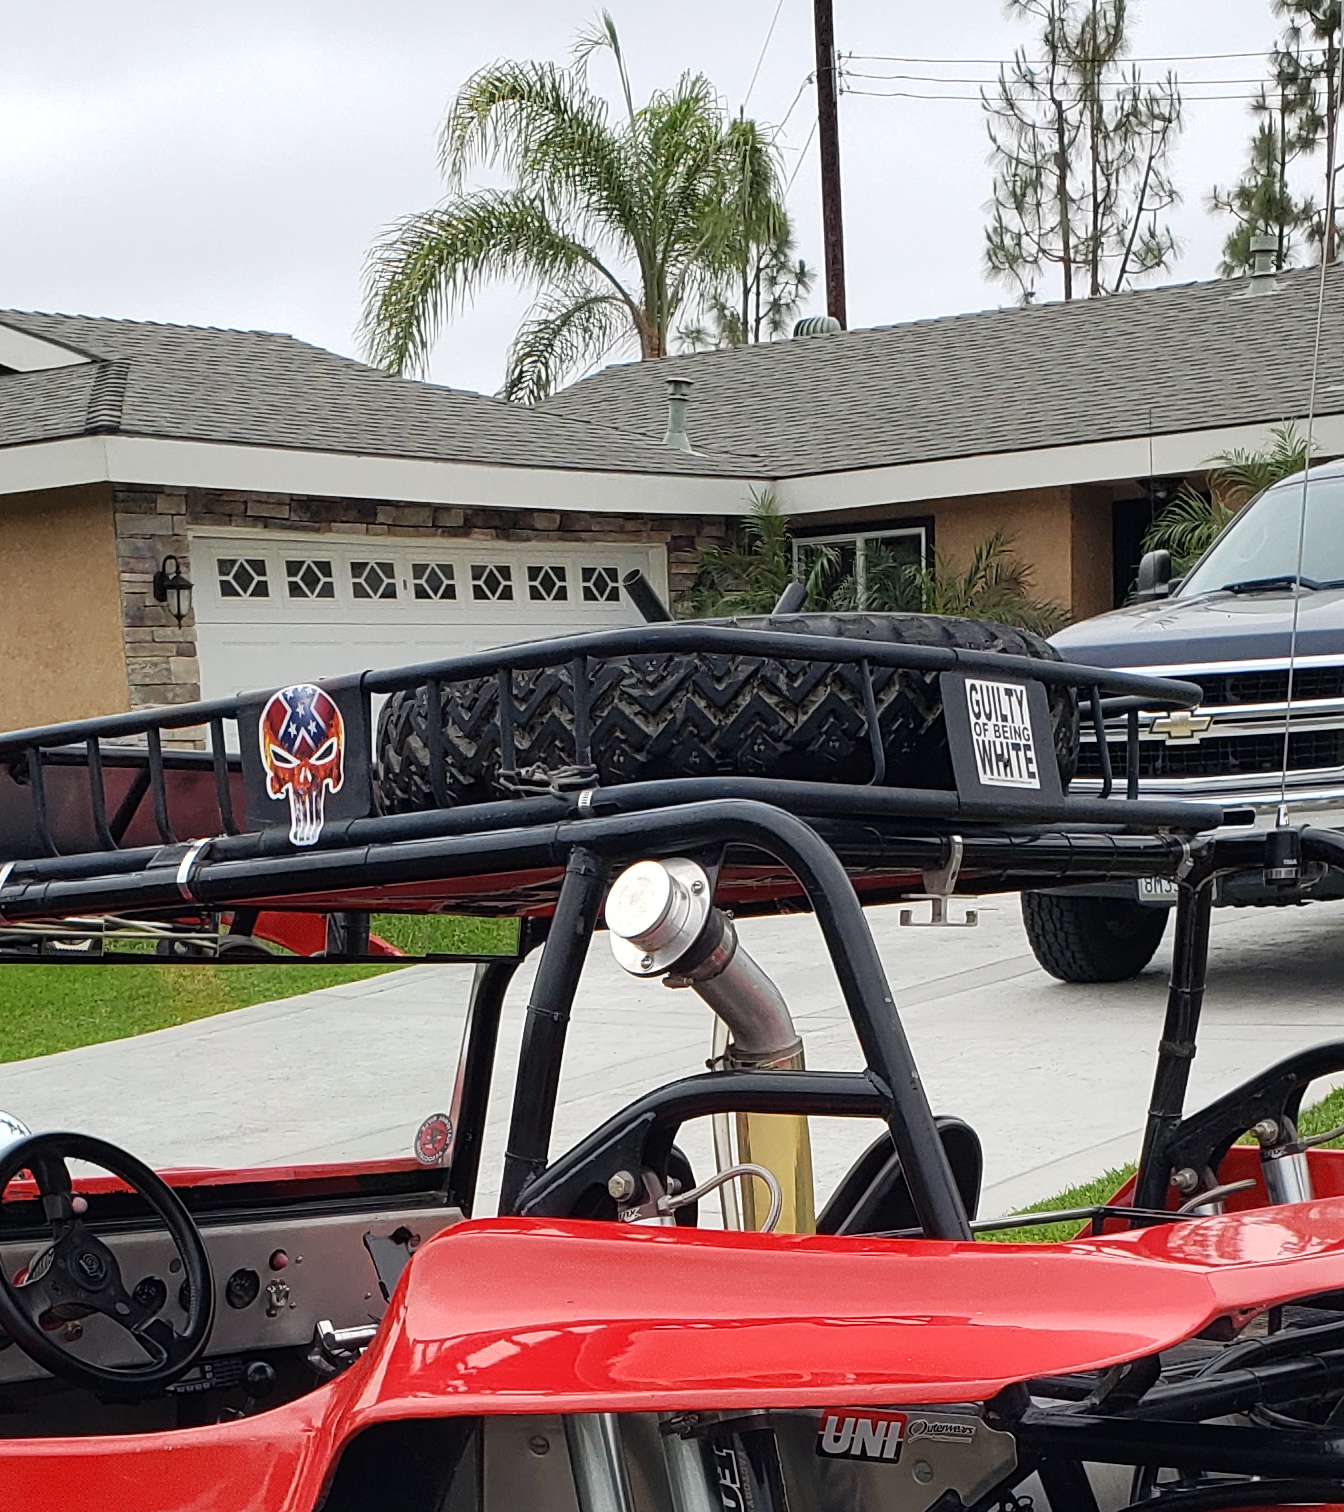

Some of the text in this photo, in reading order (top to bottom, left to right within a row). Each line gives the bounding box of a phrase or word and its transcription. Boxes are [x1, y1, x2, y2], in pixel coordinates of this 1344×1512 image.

[969, 683, 1025, 725] GUILTY
[973, 721, 1031, 742] OF BEING
[976, 738, 1037, 780] WHITE
[821, 1415, 902, 1459] UNI
